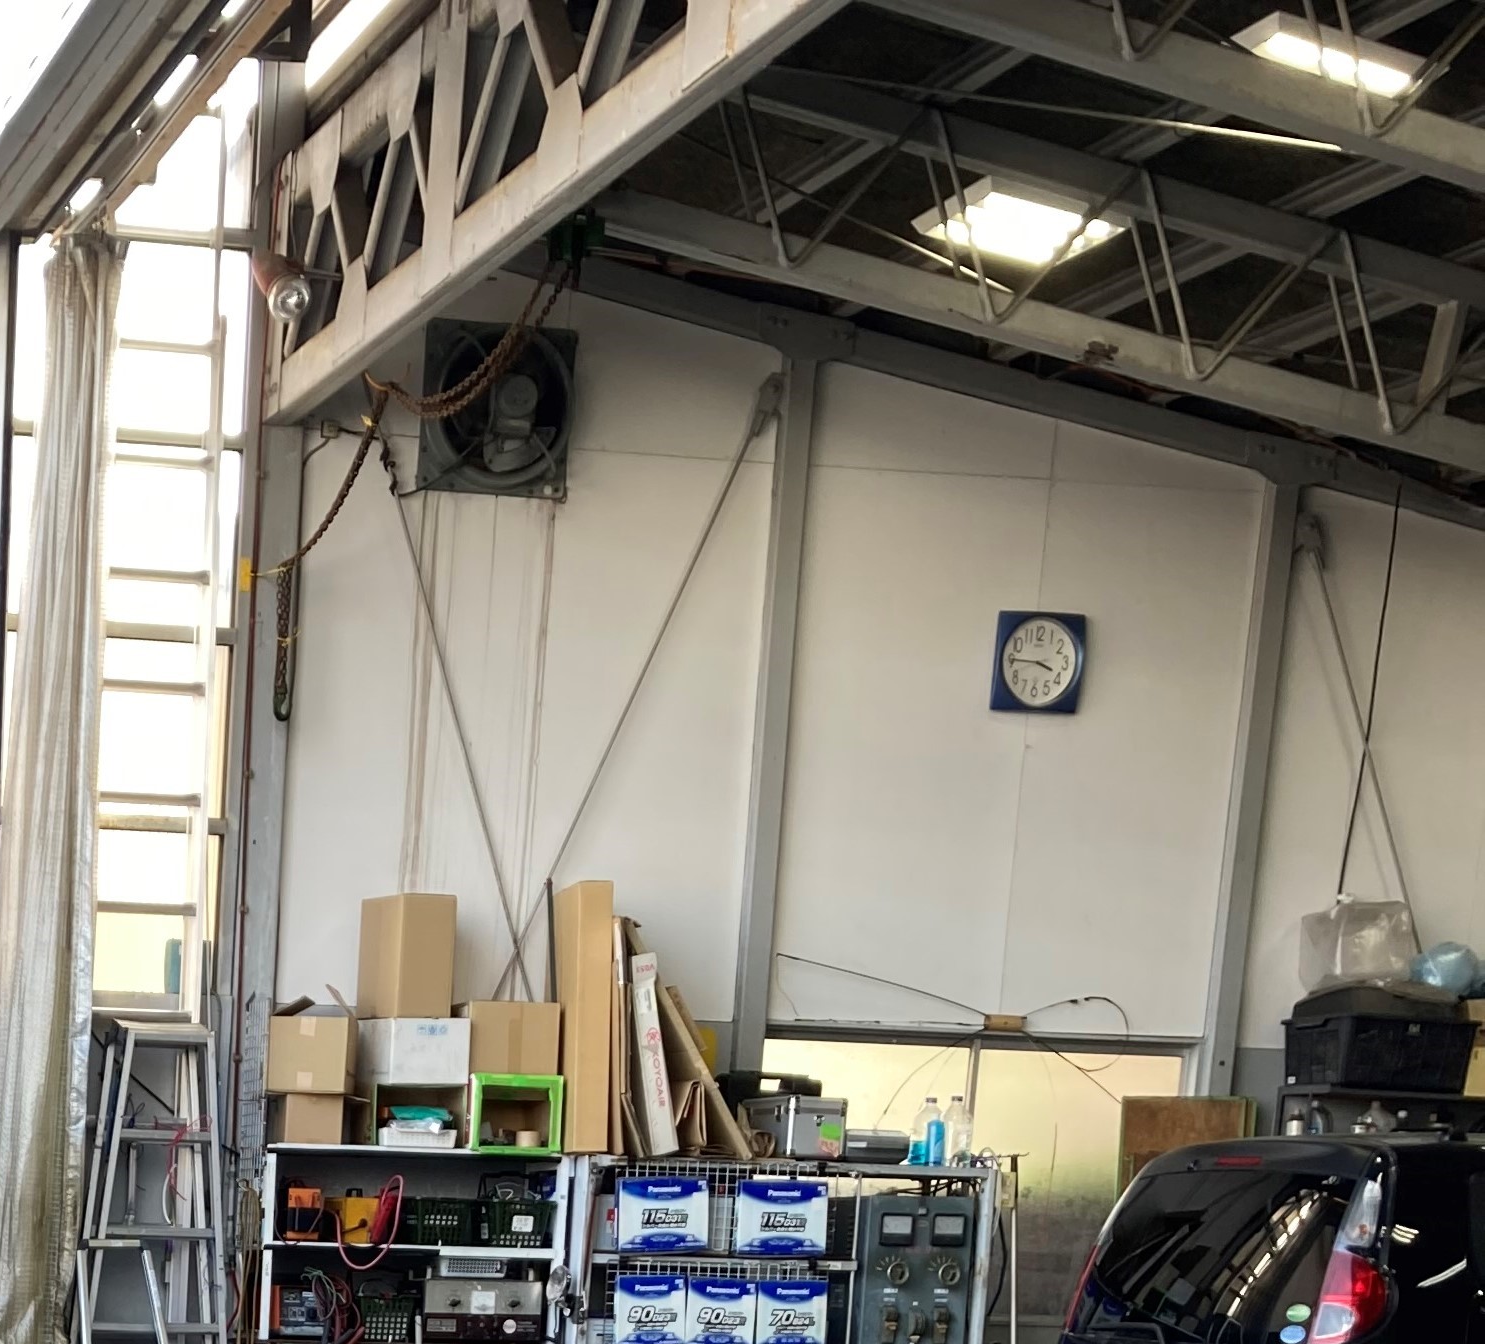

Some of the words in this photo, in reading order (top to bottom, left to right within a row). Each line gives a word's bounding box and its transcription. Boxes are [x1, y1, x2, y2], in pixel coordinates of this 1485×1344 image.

[647, 1185, 682, 1193] Panasonic
[767, 1189, 802, 1197] Panasonic
[706, 1286, 740, 1294] Panasonic
[776, 1287, 810, 1295] Panasonic
